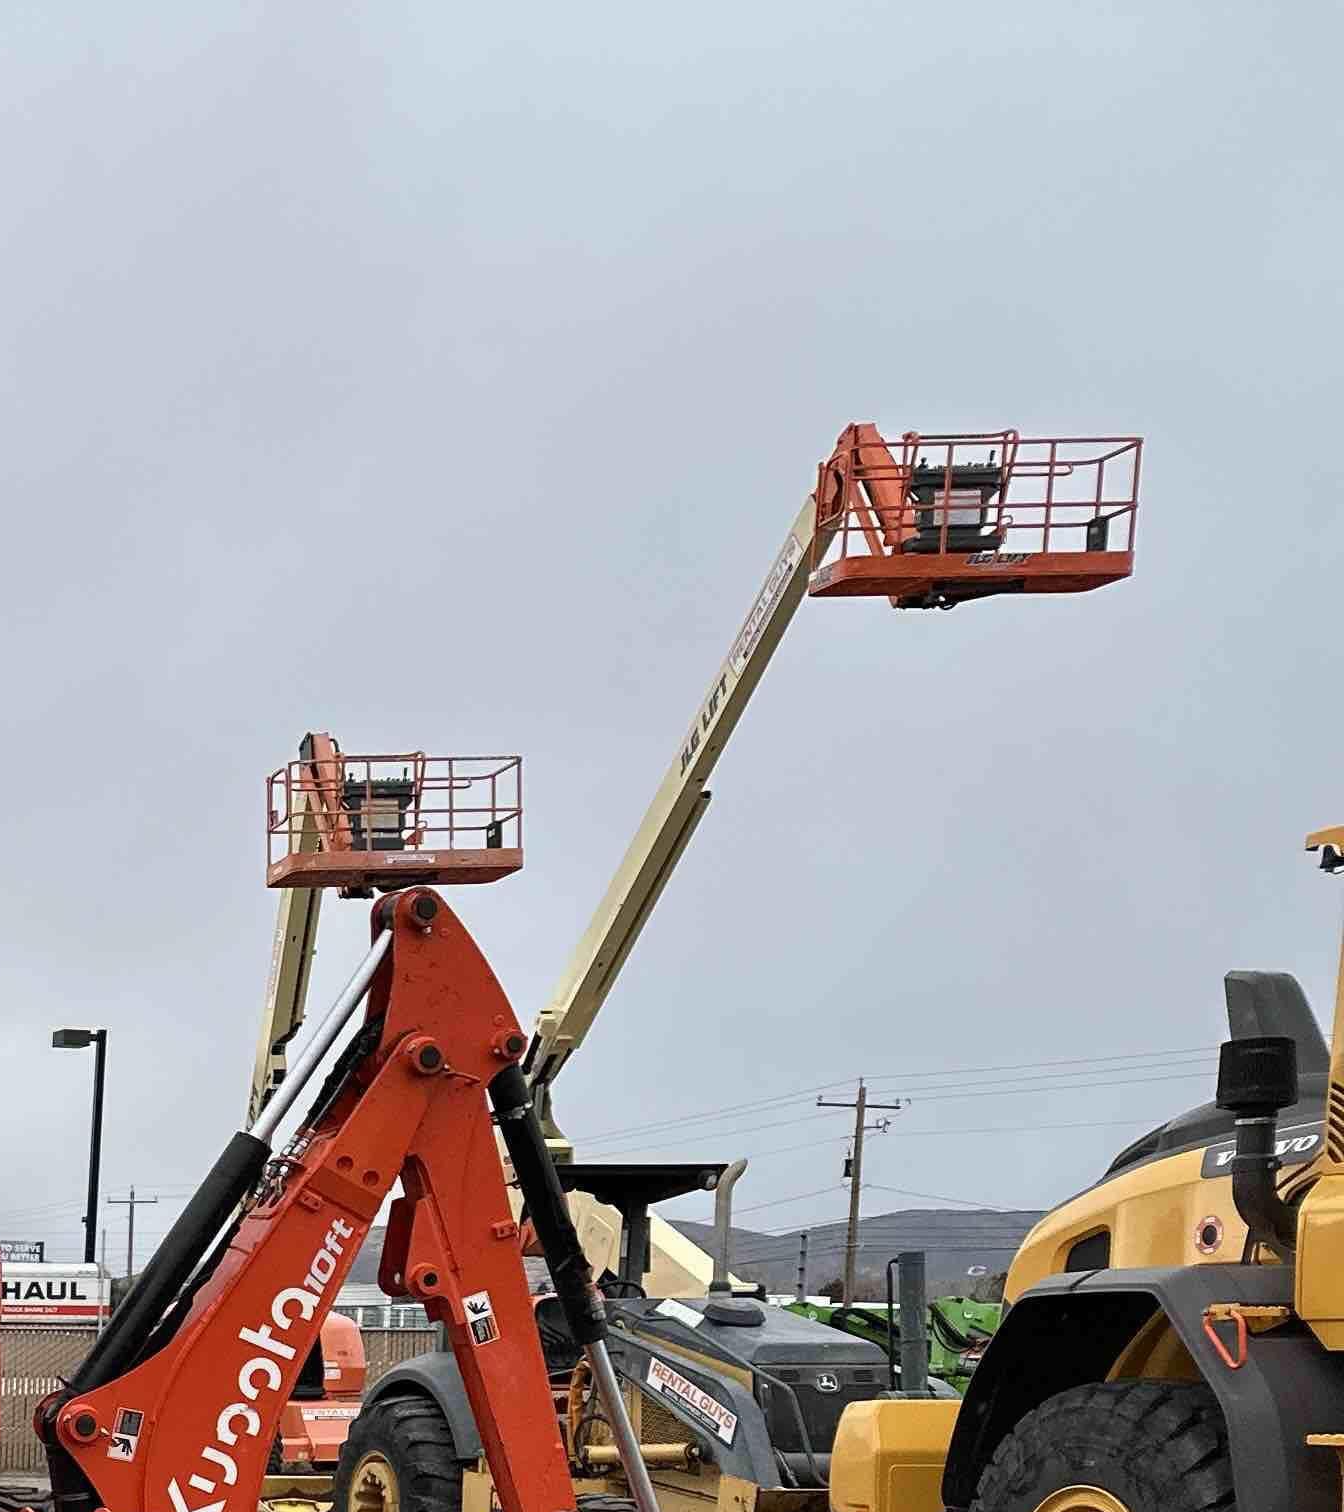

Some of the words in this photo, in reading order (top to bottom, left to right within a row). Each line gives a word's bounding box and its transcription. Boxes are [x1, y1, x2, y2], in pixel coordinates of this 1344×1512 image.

[1216, 1134, 1320, 1167] VVO
[303, 1217, 354, 1292] 10ft
[0, 1281, 87, 1300] HAUL
[651, 1361, 698, 1404] RENTAL
[698, 1395, 735, 1430] GUYS
